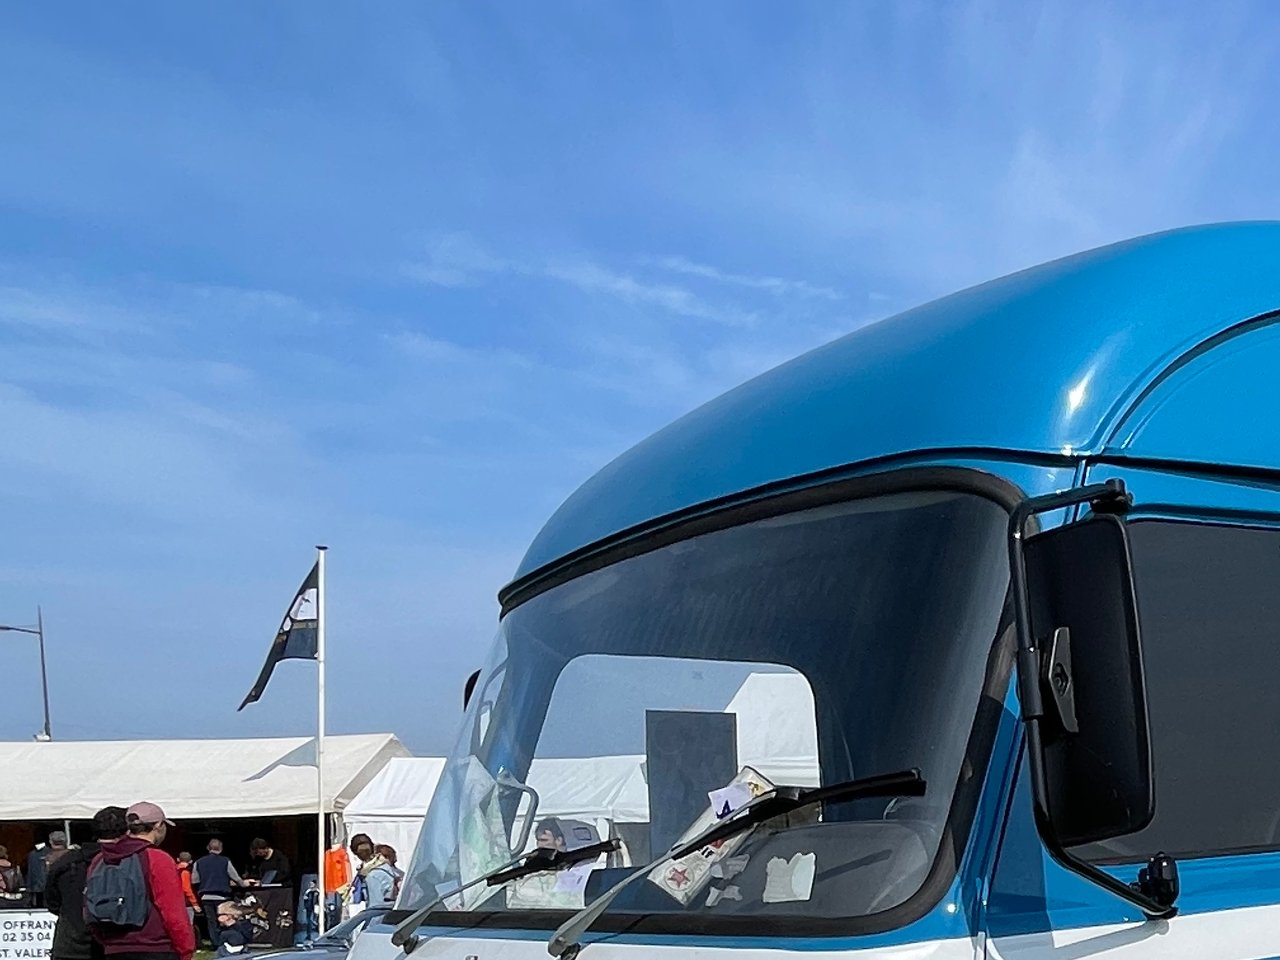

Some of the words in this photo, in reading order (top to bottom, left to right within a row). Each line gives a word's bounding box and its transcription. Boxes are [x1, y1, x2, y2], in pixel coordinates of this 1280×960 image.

[3, 932, 17, 942] 02
[20, 932, 34, 942] 35
[37, 932, 51, 941] 04
